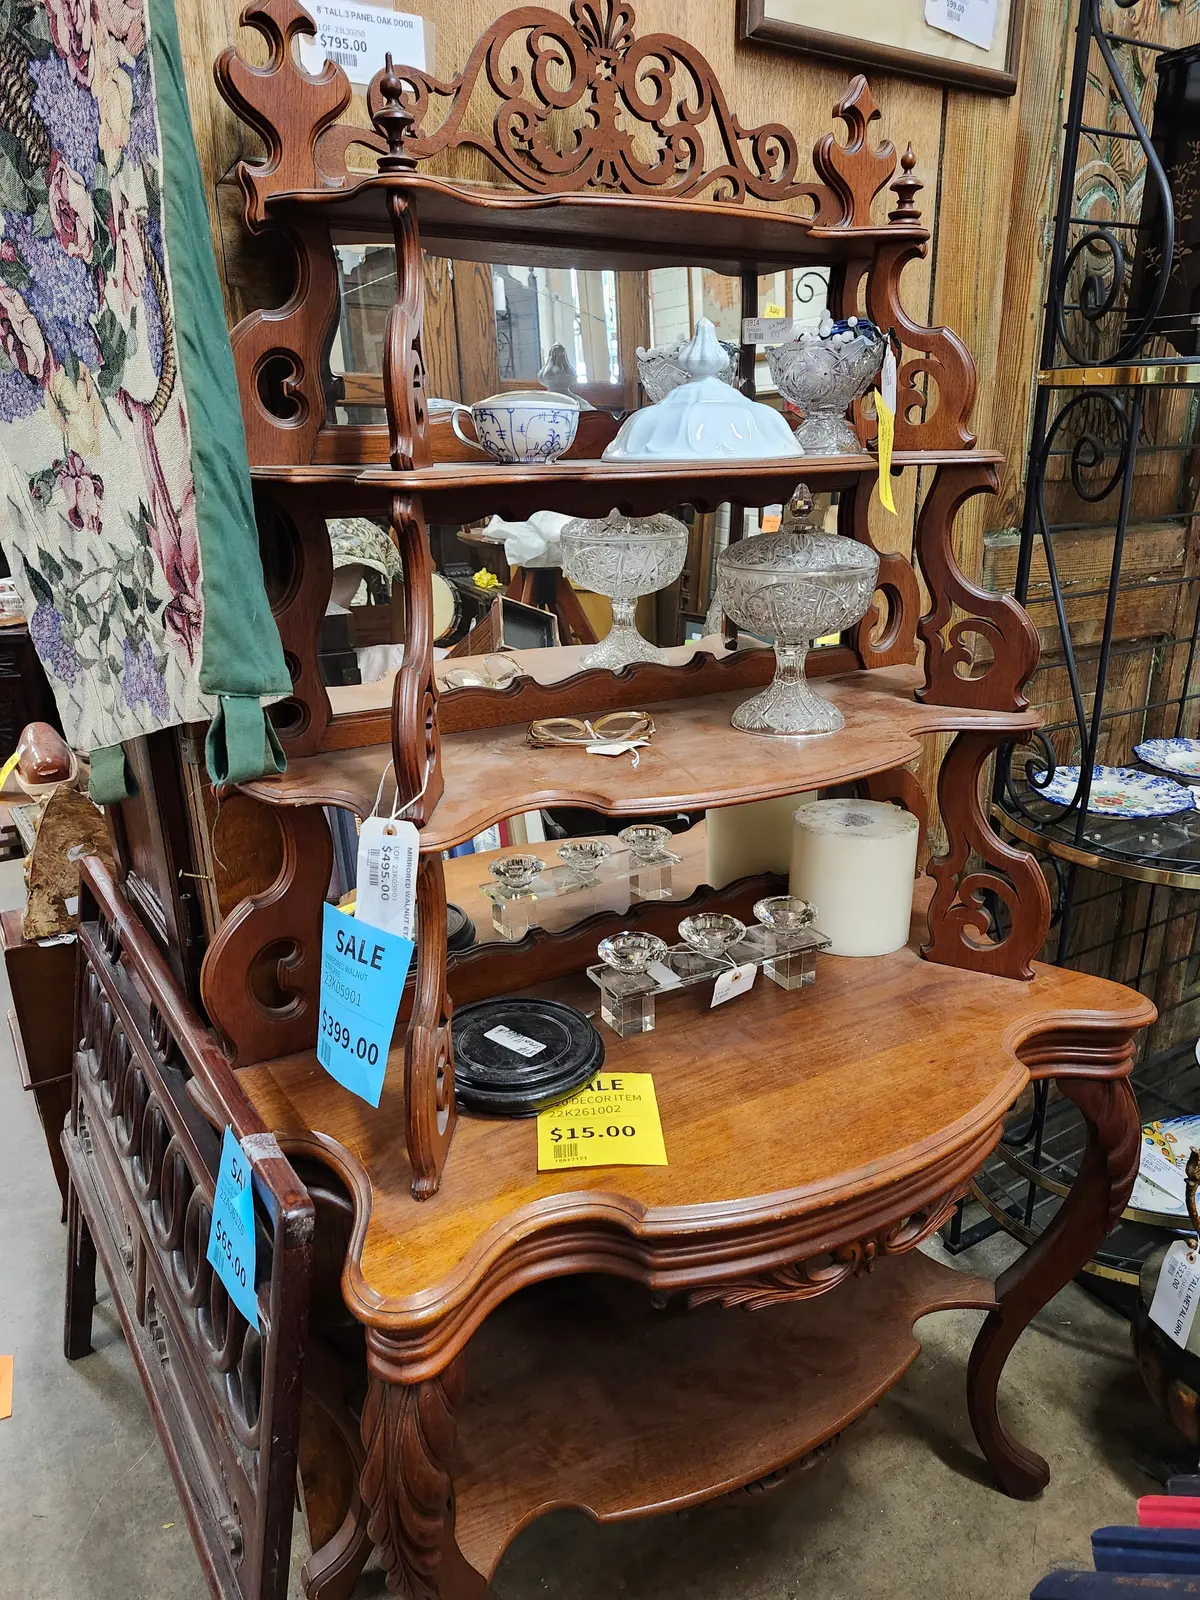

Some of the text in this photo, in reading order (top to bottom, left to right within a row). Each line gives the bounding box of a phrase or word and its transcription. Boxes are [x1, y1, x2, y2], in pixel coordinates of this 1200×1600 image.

[316, 5, 414, 29] 8' TALL 3 PANEL OAK DOOR
[320, 33, 367, 52] $795.00
[746, 319, 760, 327] 3914
[380, 845, 393, 901] $495.00
[403, 890, 411, 925] WALNUT
[335, 930, 386, 971] SALE
[344, 965, 369, 982] WALNUT
[324, 971, 361, 1007] 23K05901
[322, 1007, 379, 1066] $399.00
[582, 1079, 624, 1092] ALE
[571, 1095, 612, 1105] DECOR
[614, 1094, 642, 1102] ITEM
[549, 1105, 621, 1118] 22K261002
[550, 1125, 636, 1142] $15.00
[215, 1219, 247, 1288] $65.00
[1172, 1261, 1188, 1291] $32.00
[1188, 1274, 1200, 1293] TALL
[1178, 1293, 1193, 1319] METAL
[1173, 1318, 1184, 1337] URN
